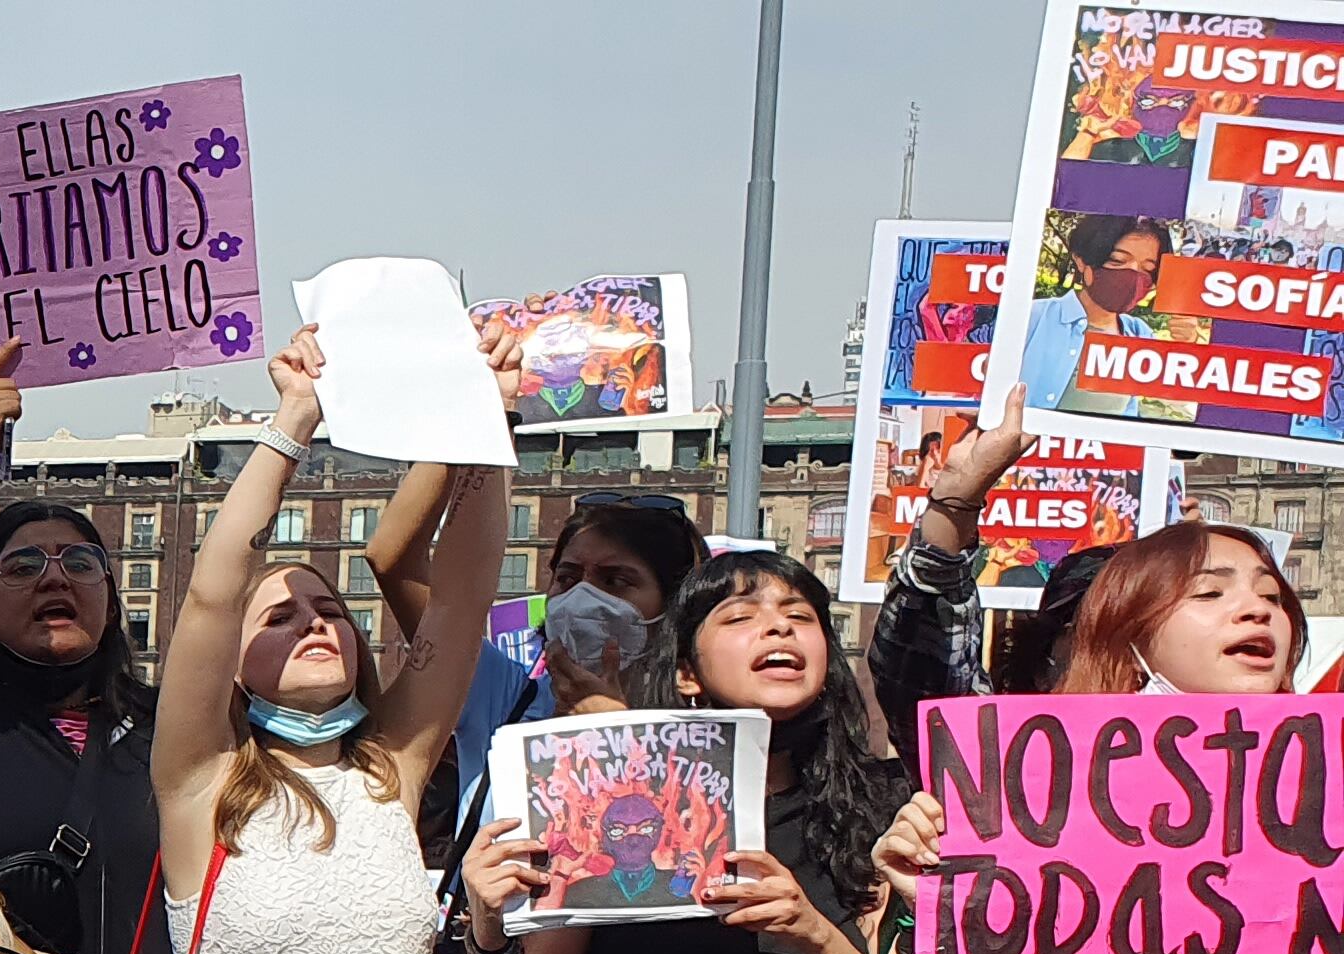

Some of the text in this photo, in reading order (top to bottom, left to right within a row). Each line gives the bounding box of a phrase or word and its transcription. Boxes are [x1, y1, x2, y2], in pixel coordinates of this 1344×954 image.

[16, 107, 135, 182] ELLAS
[2, 287, 65, 350] EL
[94, 258, 213, 343] CIELO
[885, 351, 915, 390] LA
[1084, 344, 1323, 402] MORALES
[895, 495, 1088, 529] MALES
[529, 733, 573, 763] NO
[1088, 707, 1344, 868] esta
